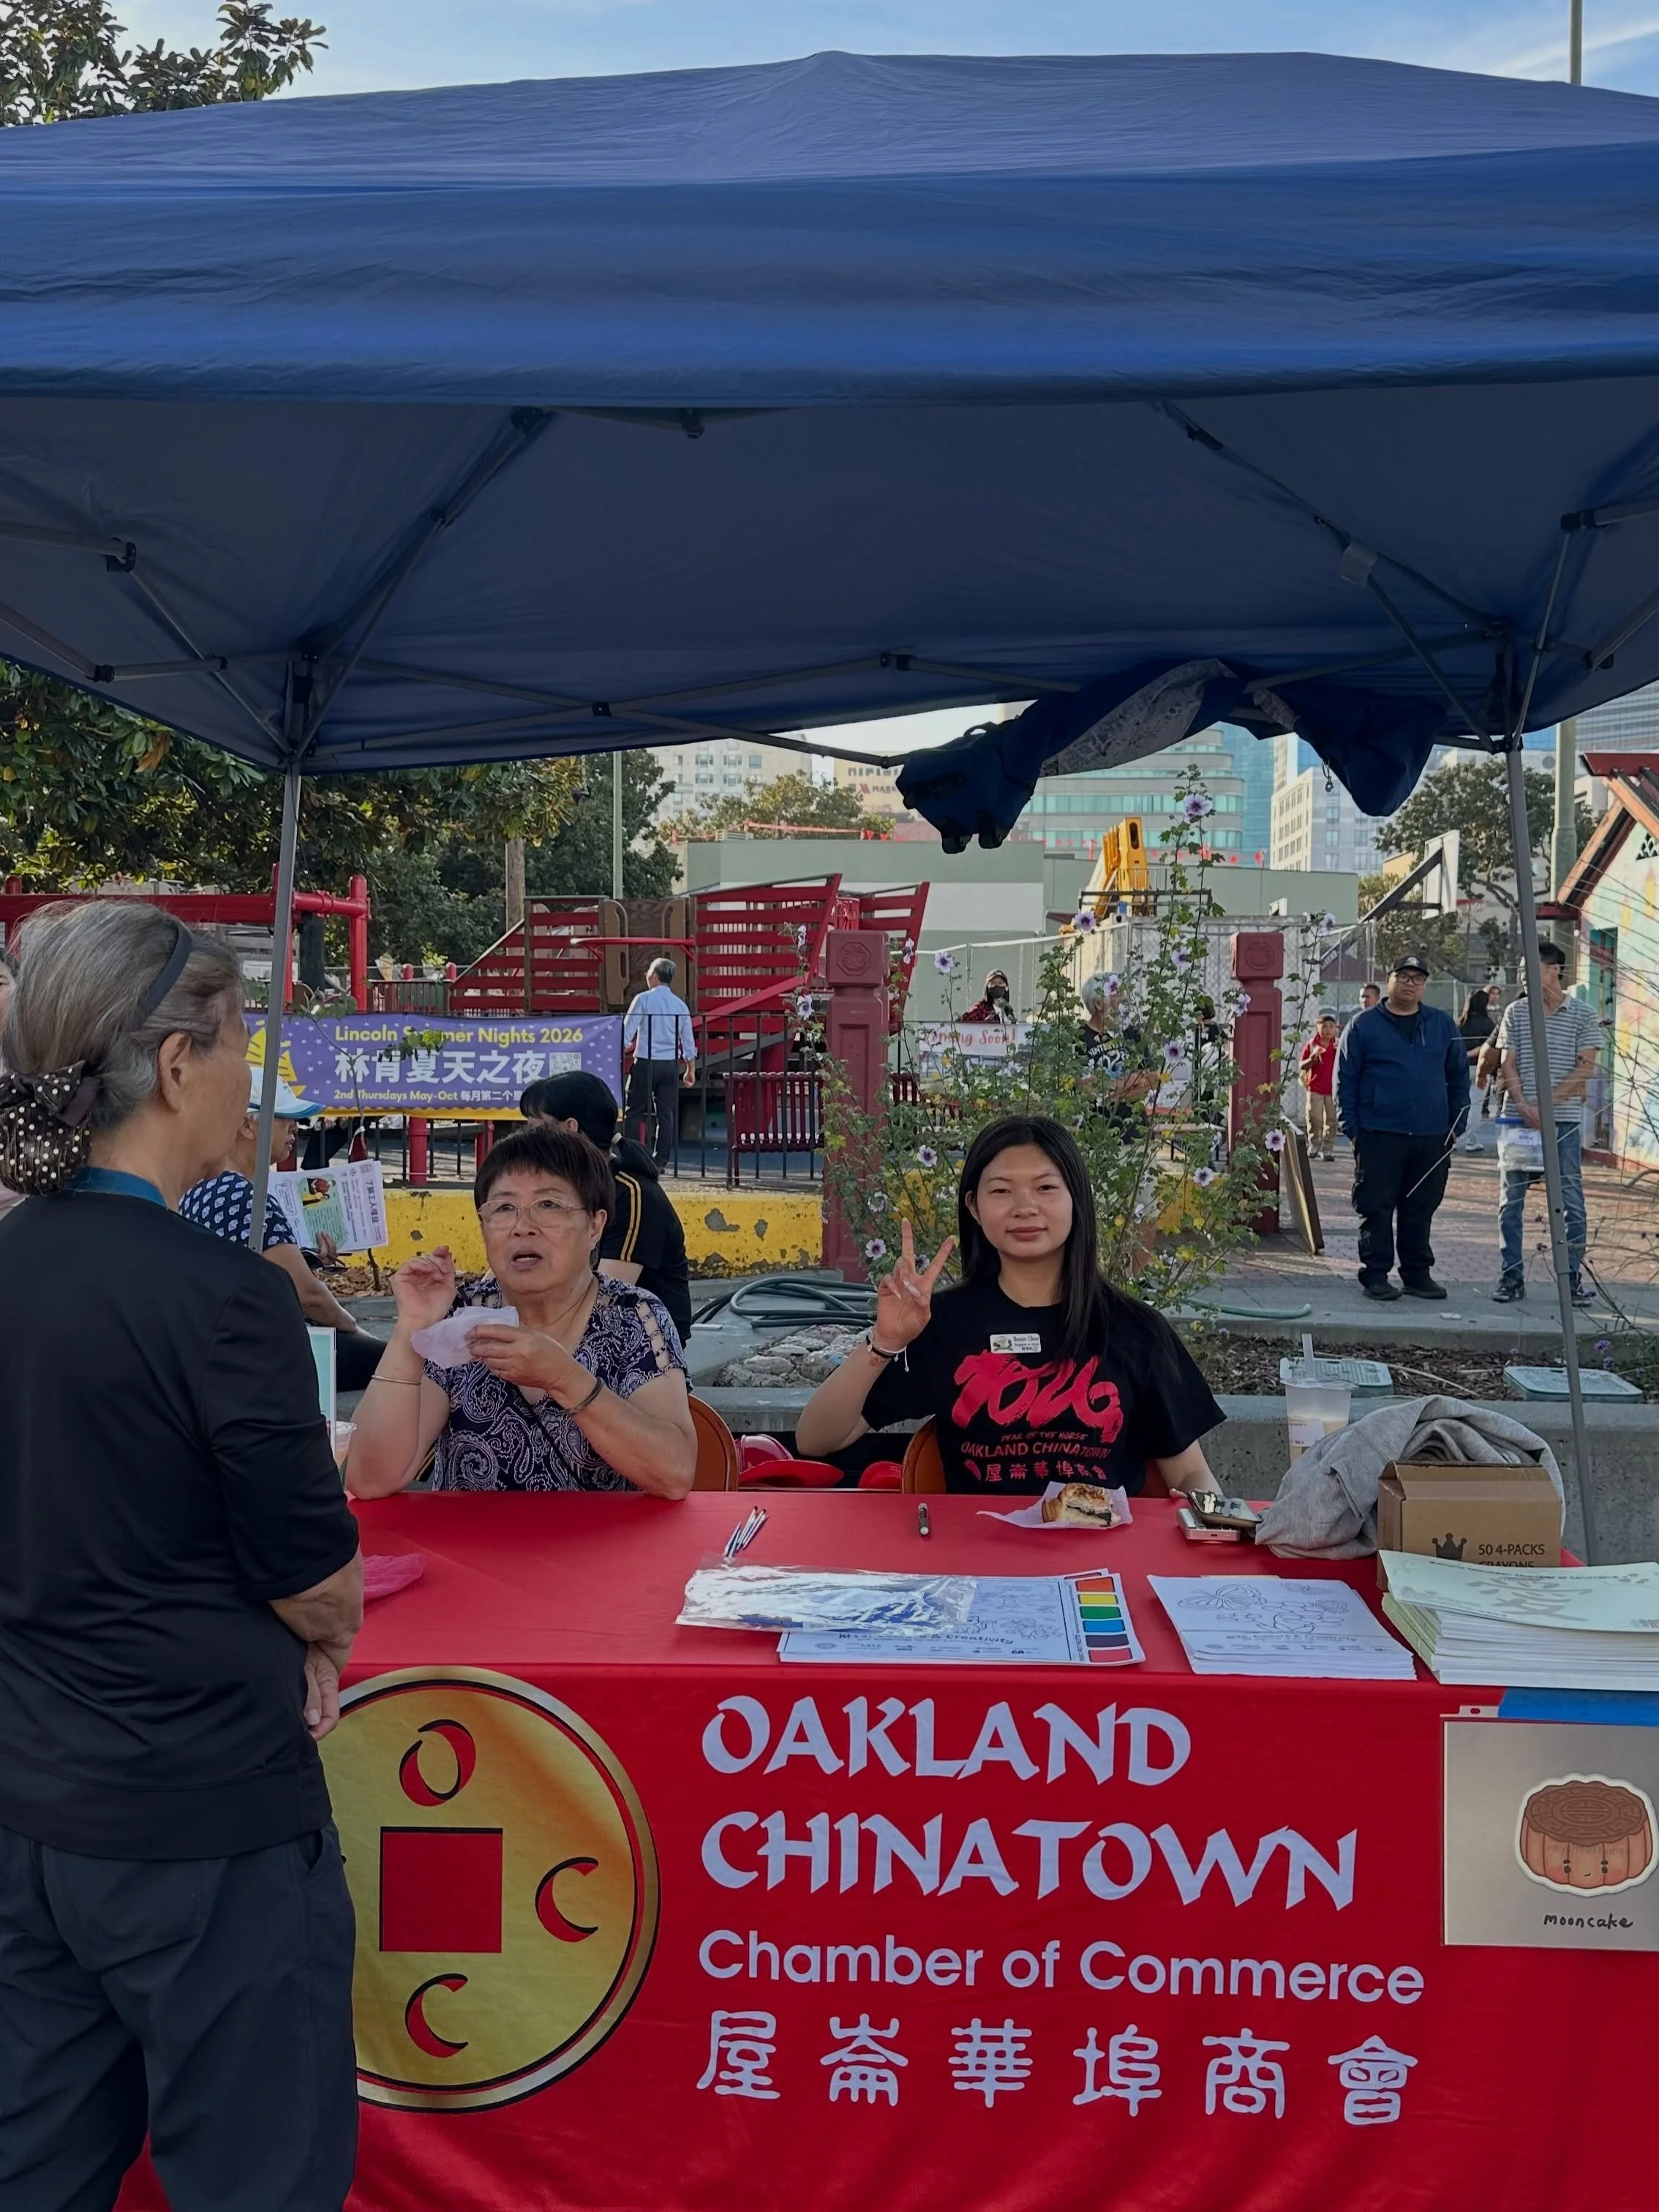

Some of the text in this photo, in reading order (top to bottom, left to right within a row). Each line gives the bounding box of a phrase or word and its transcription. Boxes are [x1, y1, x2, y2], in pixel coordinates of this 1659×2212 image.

[335, 1024, 583, 1048] Lincoln Smer Nights 2026
[334, 1047, 546, 1084] 林肯夏天之夜
[334, 1089, 354, 1100] 2nd
[357, 1089, 407, 1103] Thursdays
[1001, 1432, 1023, 1442] YEAR
[1026, 1432, 1039, 1440] OF
[1039, 1431, 1058, 1439] THE
[961, 1442, 1113, 1459] OAKLAND CHINATOWN
[1478, 1543, 1546, 1556] 50 4-PACKS
[702, 1696, 1192, 1787] OAKLAND
[701, 1811, 1358, 1911] CHINATOWN
[1543, 1913, 1633, 1930] mooncake
[699, 1930, 1425, 2005] Chamber of Commerce
[696, 2010, 1419, 2127] 屋崙華埠商會
